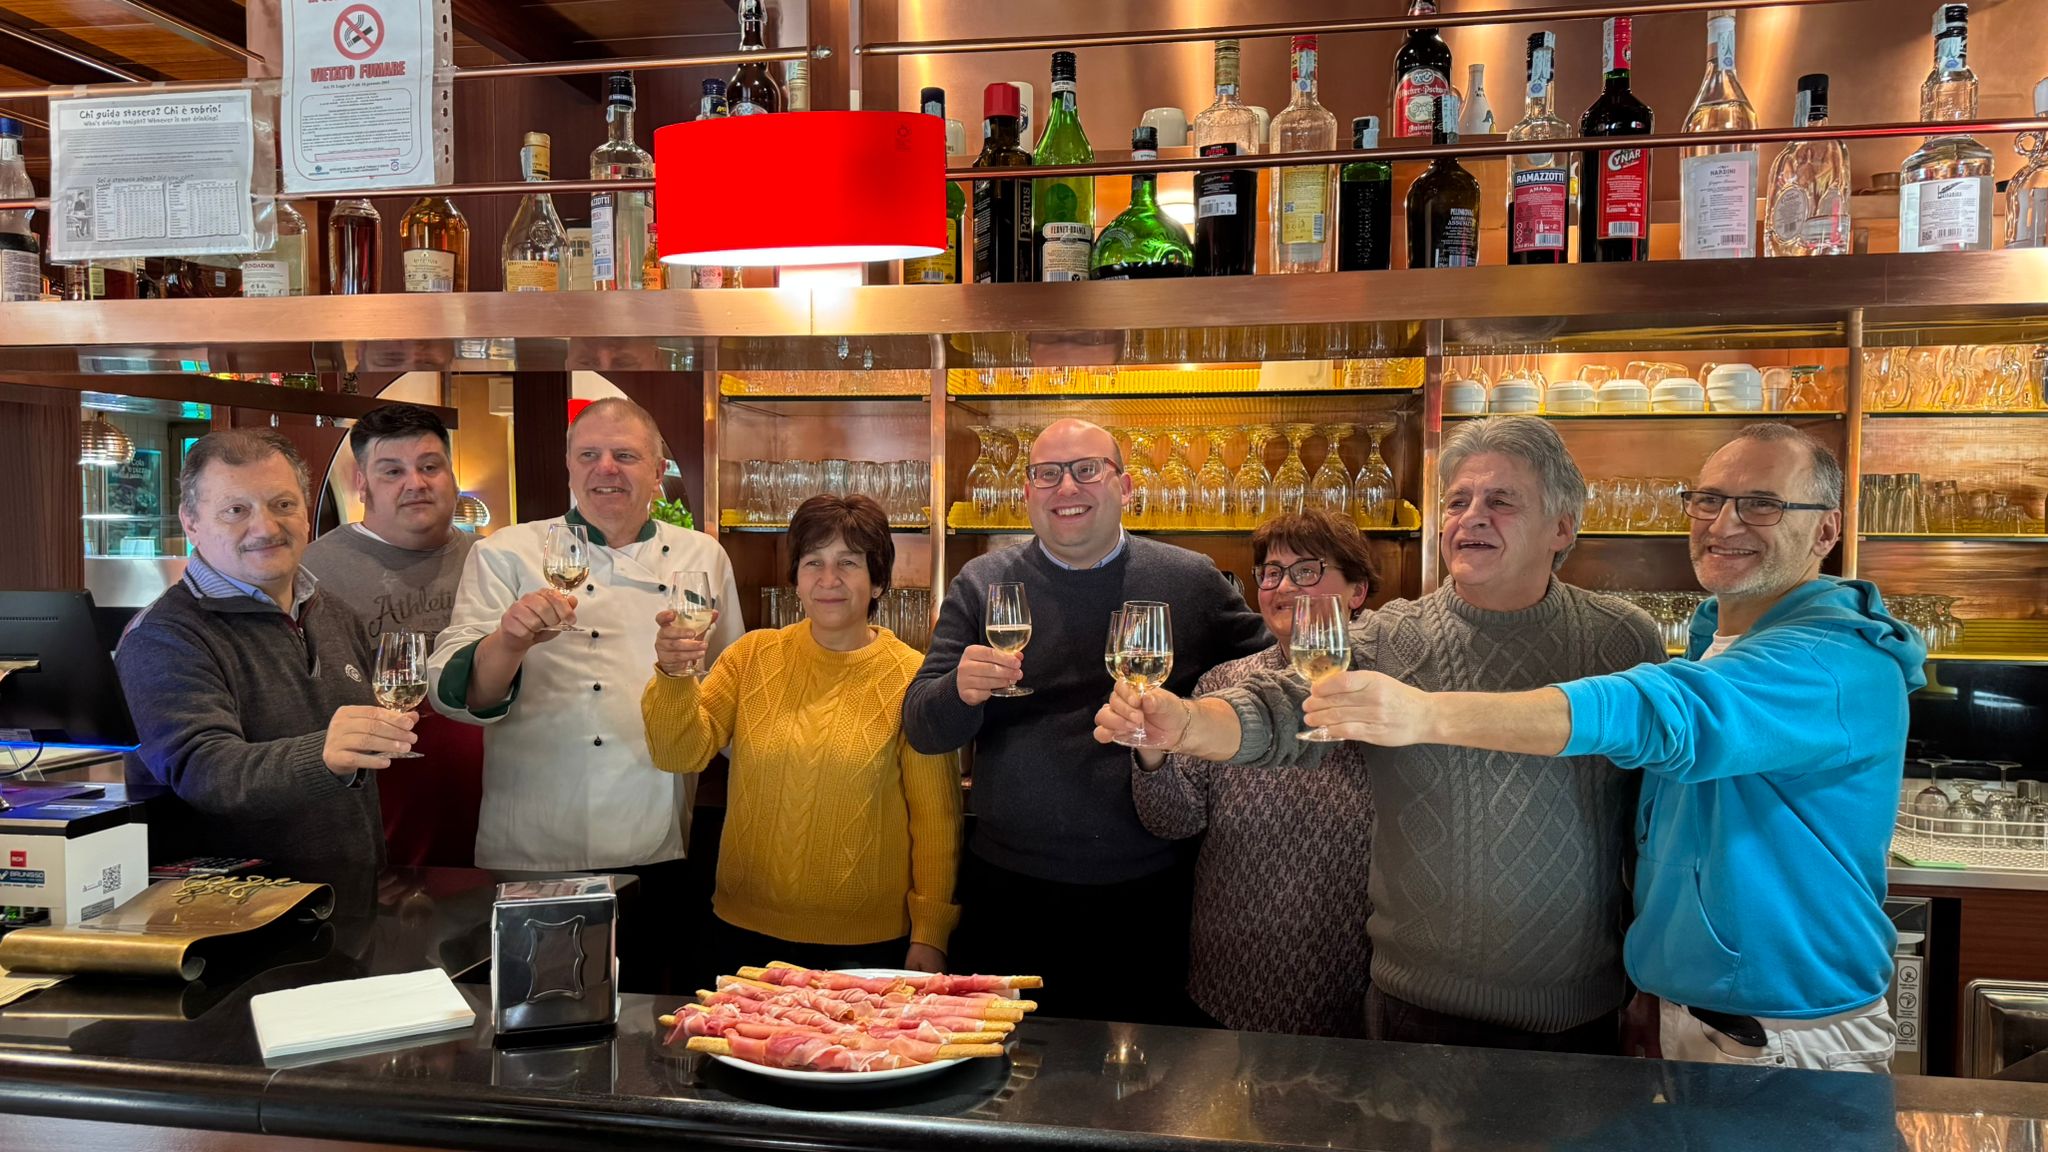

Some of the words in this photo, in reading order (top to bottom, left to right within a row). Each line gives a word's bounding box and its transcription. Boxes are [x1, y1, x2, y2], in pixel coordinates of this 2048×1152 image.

[310, 65, 355, 82] VIETATO
[360, 61, 406, 78] FUMARE
[80, 110, 94, 119] Chi
[96, 109, 120, 120] guida
[123, 107, 160, 117] stasera?
[164, 106, 178, 115] Chi
[190, 104, 221, 114] sobrio!
[1608, 149, 1641, 171] CYNAR
[1516, 172, 1564, 184] RAMAZZOTTI
[1021, 186, 1031, 234] Petrus
[368, 586, 455, 638] Athleti
